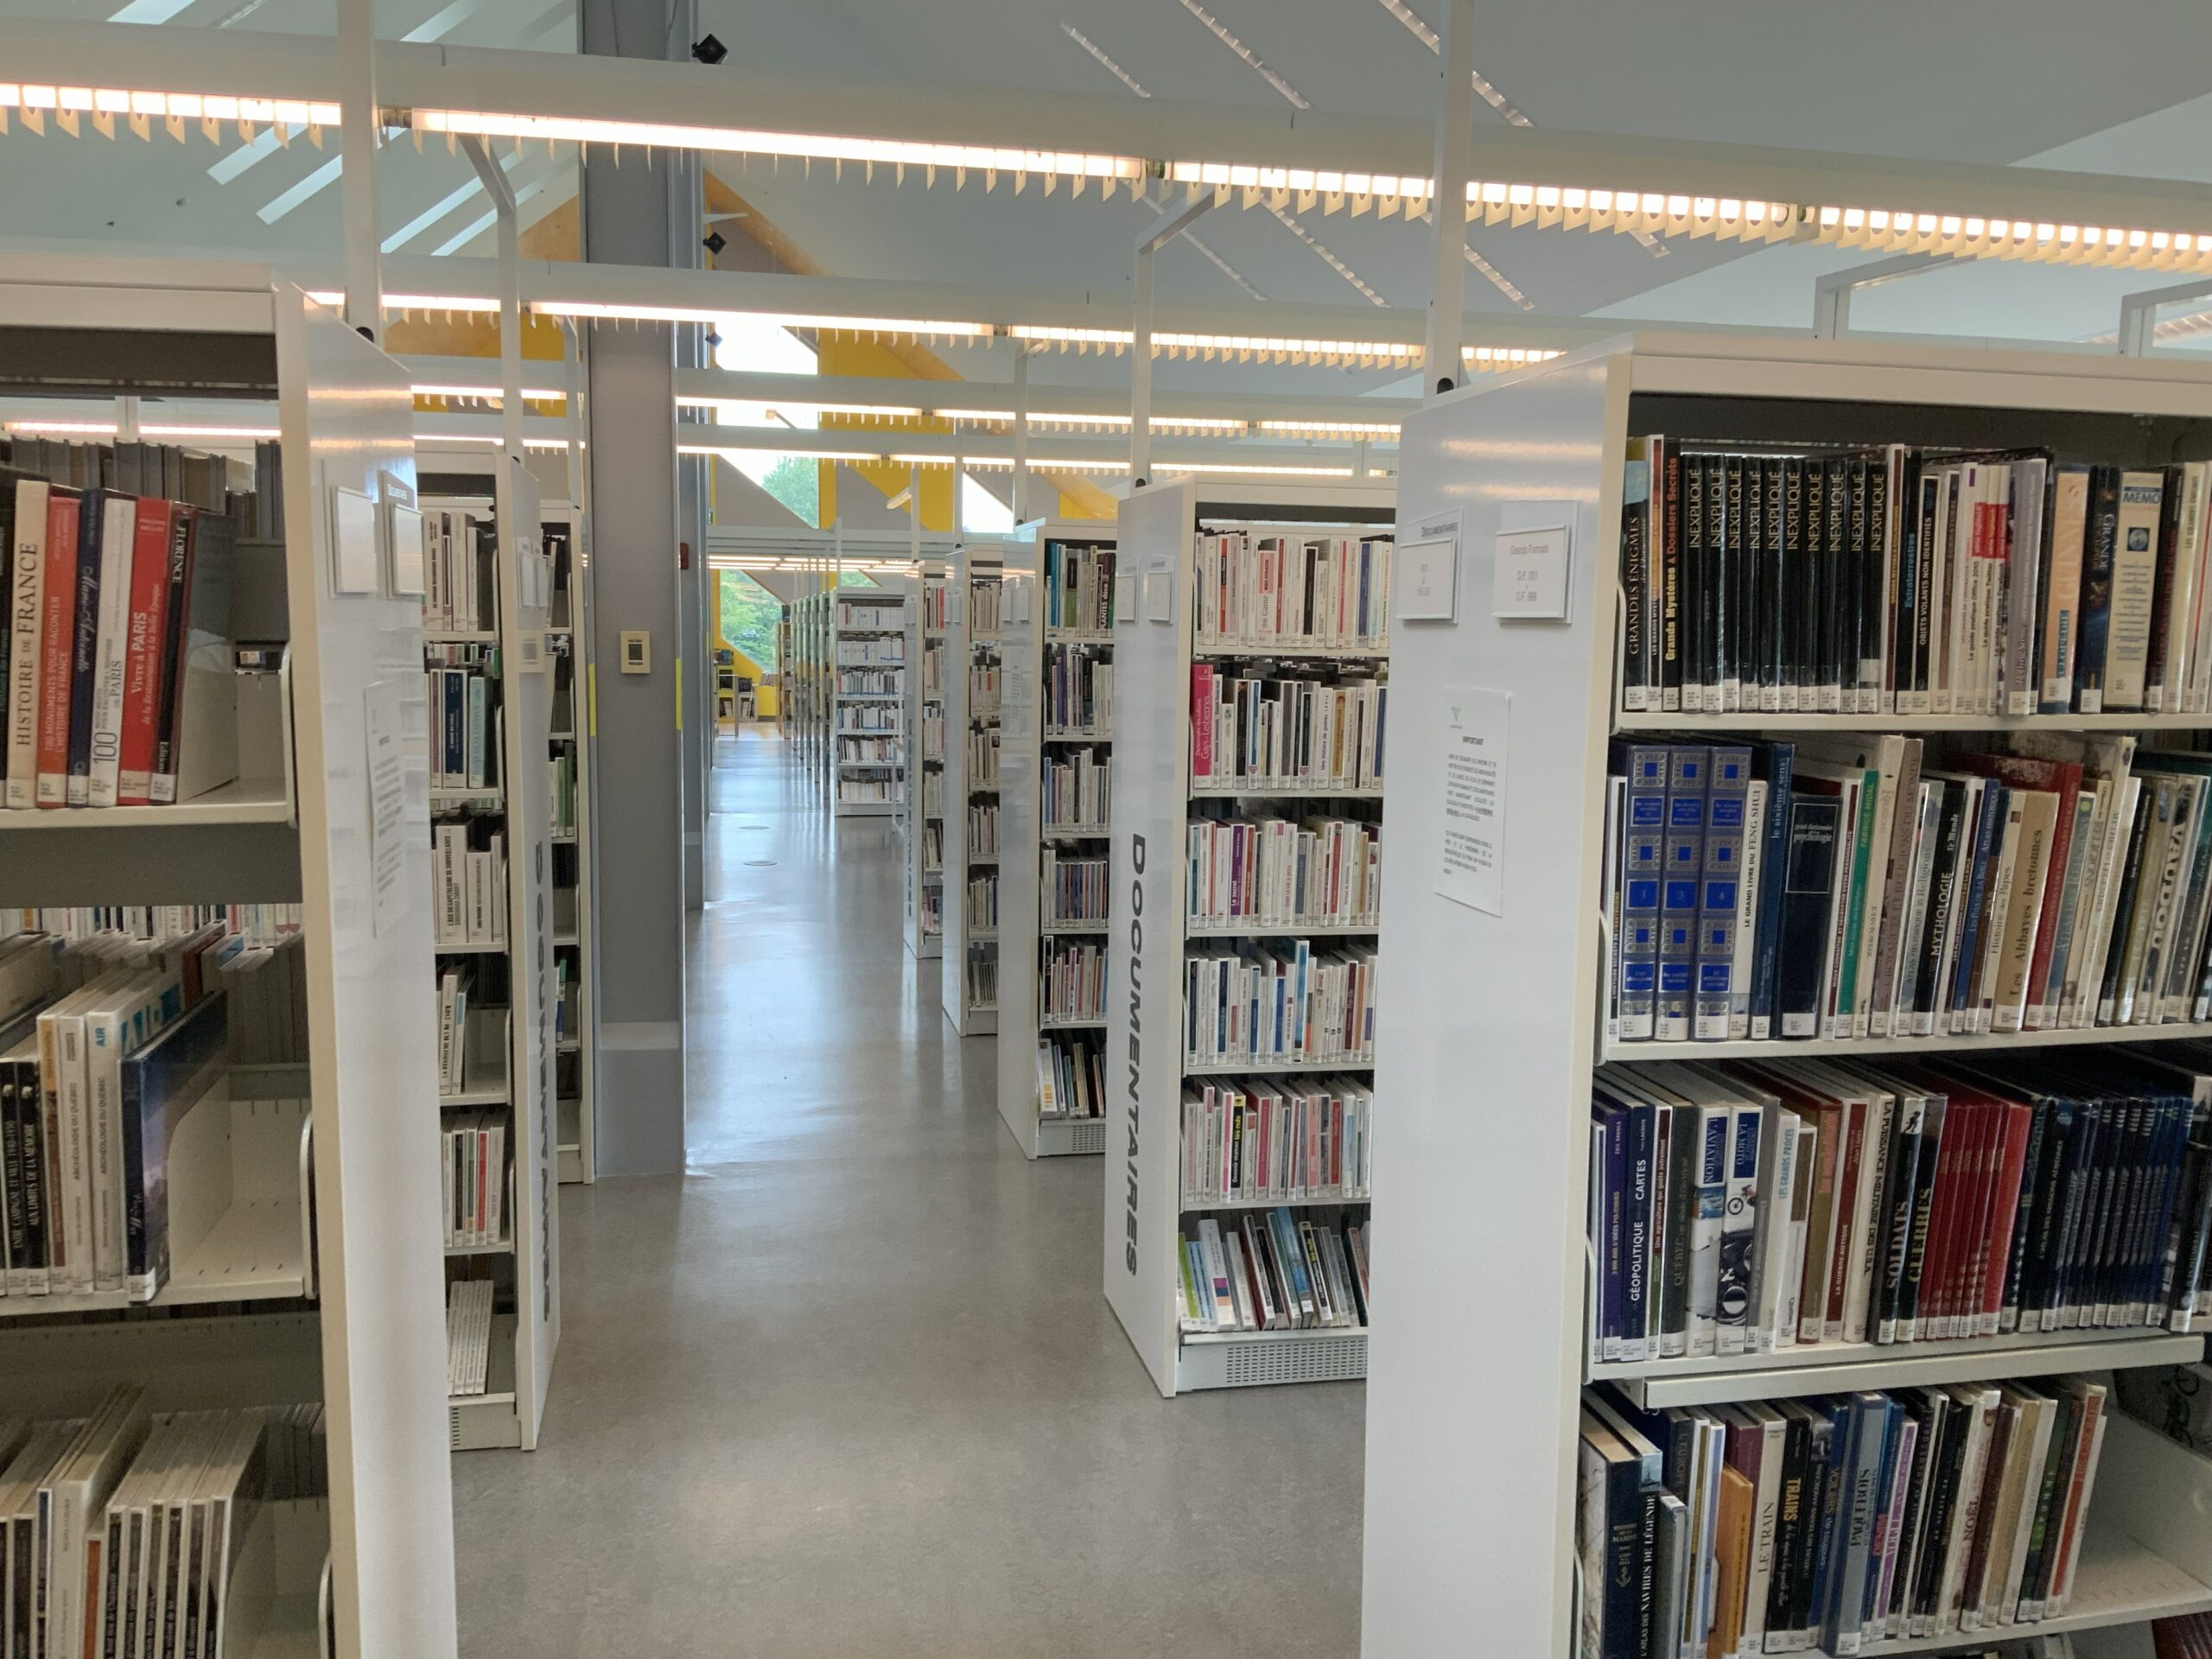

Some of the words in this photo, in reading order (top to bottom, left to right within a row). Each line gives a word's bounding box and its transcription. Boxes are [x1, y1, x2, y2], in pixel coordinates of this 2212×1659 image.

[1688, 468, 1701, 548] INEXPLIQUÉ
[1708, 468, 1722, 547] INEXPLIQUÉ
[1727, 470, 1741, 549] INEXPLIQUÉ
[1749, 471, 1762, 550] INEXPLIQUÉ
[1767, 471, 1780, 550] INEXPLIQUÉ
[1786, 472, 1800, 550] INEXPLIQUÉ
[1807, 474, 1821, 551] INEXPLIQUÉ
[1828, 474, 1844, 551] INEXPLIQUÉ
[1850, 474, 1865, 551] INEXPLIQUÉ
[1870, 474, 1885, 551] INEXPLIQUÉ
[1421, 521, 1459, 538] DOCUMENTAIRES
[1666, 505, 1677, 555] Dossiers
[1922, 518, 1931, 560] IDENTIFIÉS
[172, 524, 186, 583] FLORENCE
[1626, 518, 1640, 583] ÉNIGMES
[16, 542, 37, 633] FRANCE
[1904, 533, 1916, 608] Extraterrestres
[1665, 567, 1677, 618] Mystères
[1920, 580, 1929, 616] VOLANTS
[1984, 588, 1993, 614] pratique
[1995, 598, 2004, 624] pratique
[49, 596, 60, 645] RACONTER
[130, 613, 146, 652] PARIS
[148, 614, 157, 633] Belle
[1629, 585, 1640, 655] GRANDES
[1919, 618, 1928, 645] OBJETS
[1970, 602, 1979, 628] pratique
[22, 639, 31, 652] DE
[48, 647, 58, 673] POUR
[1664, 621, 1675, 660] Grands
[59, 651, 68, 688] FRANCE
[109, 661, 123, 697] PARIS
[130, 664, 145, 694] Vivre
[143, 653, 155, 703] Restauration
[16, 660, 33, 746] HISTOIRE
[46, 676, 57, 734] MONUMENTS
[59, 690, 67, 698] DE
[45, 735, 54, 753] 100
[57, 701, 67, 753] L'HISTOIRE
[92, 732, 118, 766] 100
[1777, 761, 1786, 785] sens
[1904, 757, 1919, 803] MONDE
[1751, 790, 1761, 817] SHUI
[1771, 786, 1784, 827] sixième
[1864, 782, 1875, 810] MIDAL
[1903, 805, 1913, 825] DU
[1984, 788, 1998, 830] HISTORIQUE
[1748, 820, 1758, 850] FENG
[1770, 828, 1780, 839] le
[1860, 812, 1872, 848] FABRICE
[1948, 813, 1959, 841] Monde
[1980, 831, 1990, 853] ATLAS
[2105, 811, 2120, 852] MYTHES
[1748, 854, 1755, 865] DU
[1893, 828, 1911, 896] RELIGIONS
[1976, 861, 1986, 880] BIBLE
[2023, 830, 2043, 896] bretonnes
[2065, 817, 2089, 887] RELIGIONS
[2084, 821, 2103, 888] RELIGIONS
[1915, 848, 1932, 897] Religions
[1999, 868, 2011, 895] Papes
[2151, 823, 2185, 949] VAUDOU
[1744, 918, 1751, 928] LE
[1931, 873, 1951, 956] MYTHOLOGIE
[1998, 899, 2006, 912] des
[1883, 919, 1897, 987] CROYANCES
[1910, 909, 1923, 958] HISTORIQUE
[1992, 915, 2004, 955] Histoire
[2014, 906, 2033, 963] Abbayes
[1906, 960, 1916, 983] ATLAS
[2010, 973, 2024, 996] Les
[95, 1028, 105, 1047] AIR
[1126, 834, 1147, 1275] DOCUMENTAIRES
[67, 1083, 78, 1113] QUÉBEC
[96, 1077, 106, 1108] QUÉBEC
[1882, 1102, 1892, 1116] LA
[70, 1116, 79, 1126] DU
[99, 1109, 106, 1120] DU
[1738, 1122, 1747, 1136] LA
[22, 1124, 35, 1157] MÉMOIRE
[71, 1128, 80, 1180] ARCHÉOLOGIE
[99, 1122, 108, 1174] ARCHÉOLOGIE
[1657, 1140, 1666, 1171] autrement
[1704, 1118, 1719, 1182] L'AVIATION
[1736, 1138, 1746, 1165] MOTO
[1782, 1128, 1795, 1156] PROCÈS
[1877, 1119, 1891, 1173] PUISSANCE
[24, 1159, 36, 1168] LA
[1635, 1160, 1646, 1200] CARTES
[1656, 1172, 1665, 1190] goûte
[1780, 1158, 1792, 1186] GRANDS
[10, 1189, 22, 1227] CAMPAGNE
[26, 1182, 38, 1211] LIMITES
[1778, 1188, 1788, 1199] LES
[1870, 1176, 1883, 1225] MILITAIRE
[27, 1211, 39, 1226] AUX
[1656, 1202, 1664, 1235] agriculture
[1867, 1228, 1876, 1247] DES
[1907, 1188, 1931, 1283] GUERRES
[1840, 1225, 1848, 1255] ANTIQUE
[1888, 1203, 1908, 1289] SOLDATS
[1630, 1222, 1643, 1301] GÉOPOLITIQUE
[1672, 1237, 1685, 1287] QUÉBEC
[1836, 1257, 1845, 1286] GUERRE
[1783, 1478, 1802, 1521] TRAINS
[1826, 1466, 1839, 1513] VOILIERS
[1850, 1470, 1871, 1547] PAQUEBOTS
[1644, 1495, 1656, 1545] LÉGENDE
[1760, 1502, 1774, 1551] TRAIN
[1872, 1514, 1887, 1557] DENIM
[1962, 1496, 1980, 1542] NOËL
[1643, 1548, 1654, 1562] DE
[1758, 1554, 1770, 1573] LE
[1820, 1527, 1832, 1565] toujours
[1641, 1565, 1654, 1612] NAVIRES
